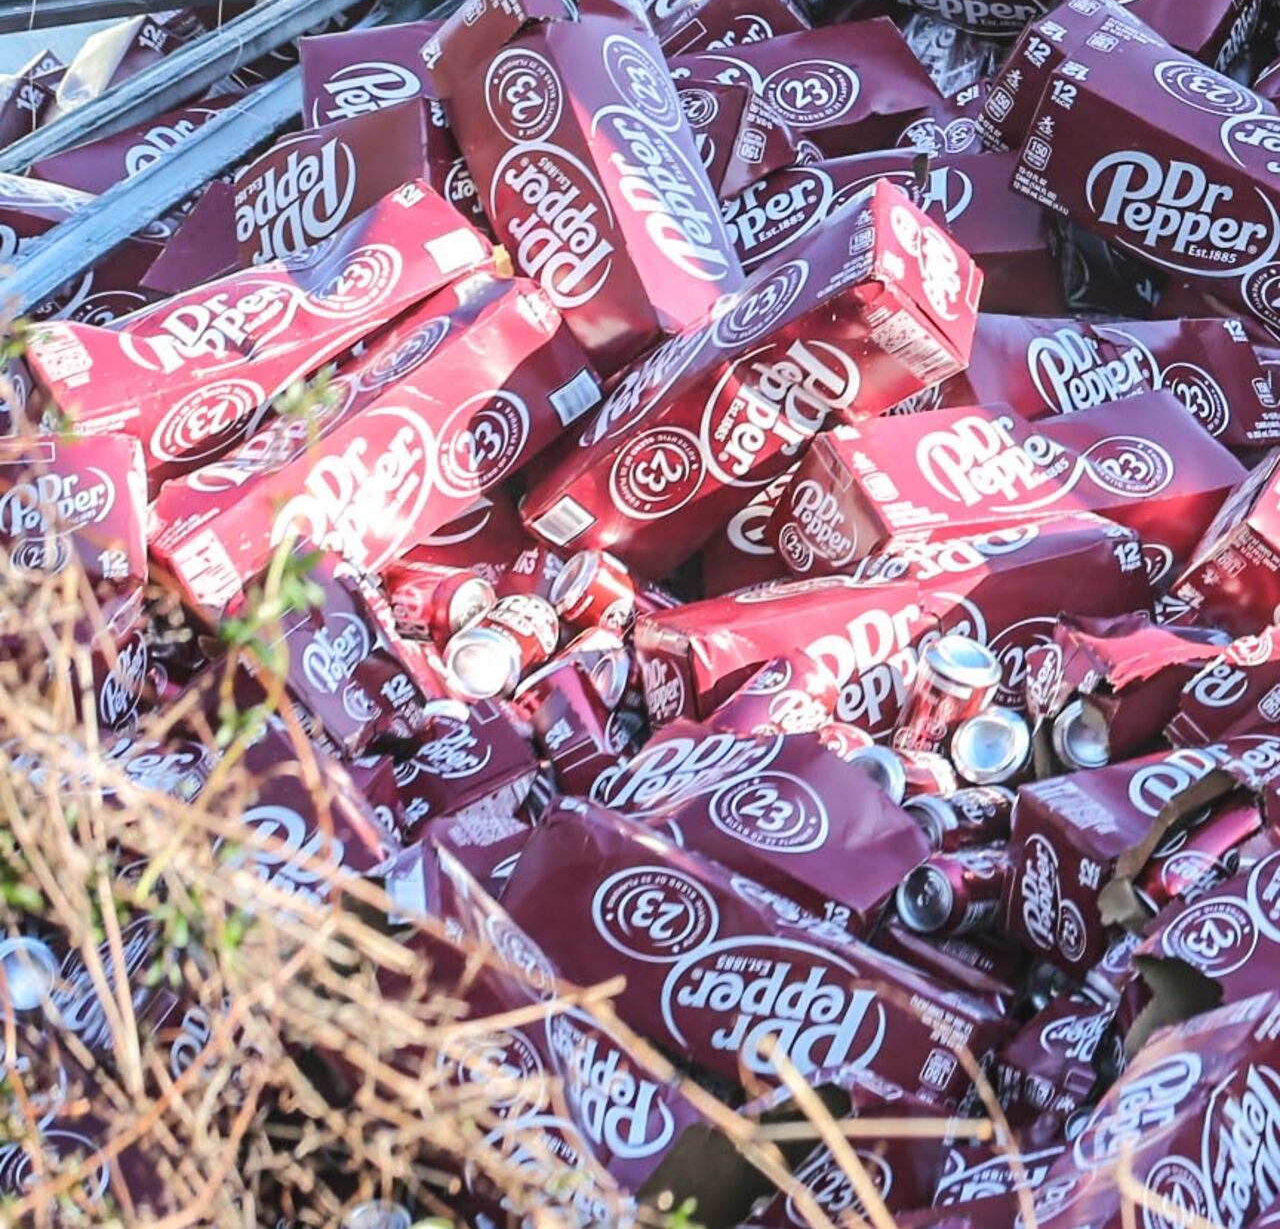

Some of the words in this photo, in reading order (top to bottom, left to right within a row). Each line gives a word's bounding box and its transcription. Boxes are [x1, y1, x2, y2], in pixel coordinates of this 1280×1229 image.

[508, 79, 538, 112] 23
[787, 75, 828, 109] 23
[1087, 151, 1267, 250] Pepper
[1161, 161, 1233, 214] Dr
[505, 164, 615, 308] Pepper
[1188, 244, 1237, 264] Est.1885
[956, 419, 1015, 466] Dr
[633, 452, 684, 488] 23
[791, 480, 851, 551] Pepper
[815, 492, 844, 527] Dr
[97, 550, 129, 567] 12
[1114, 543, 1139, 564] 12
[741, 795, 793, 828] 23
[631, 897, 680, 929] 23
[678, 968, 880, 1071] Pepper
